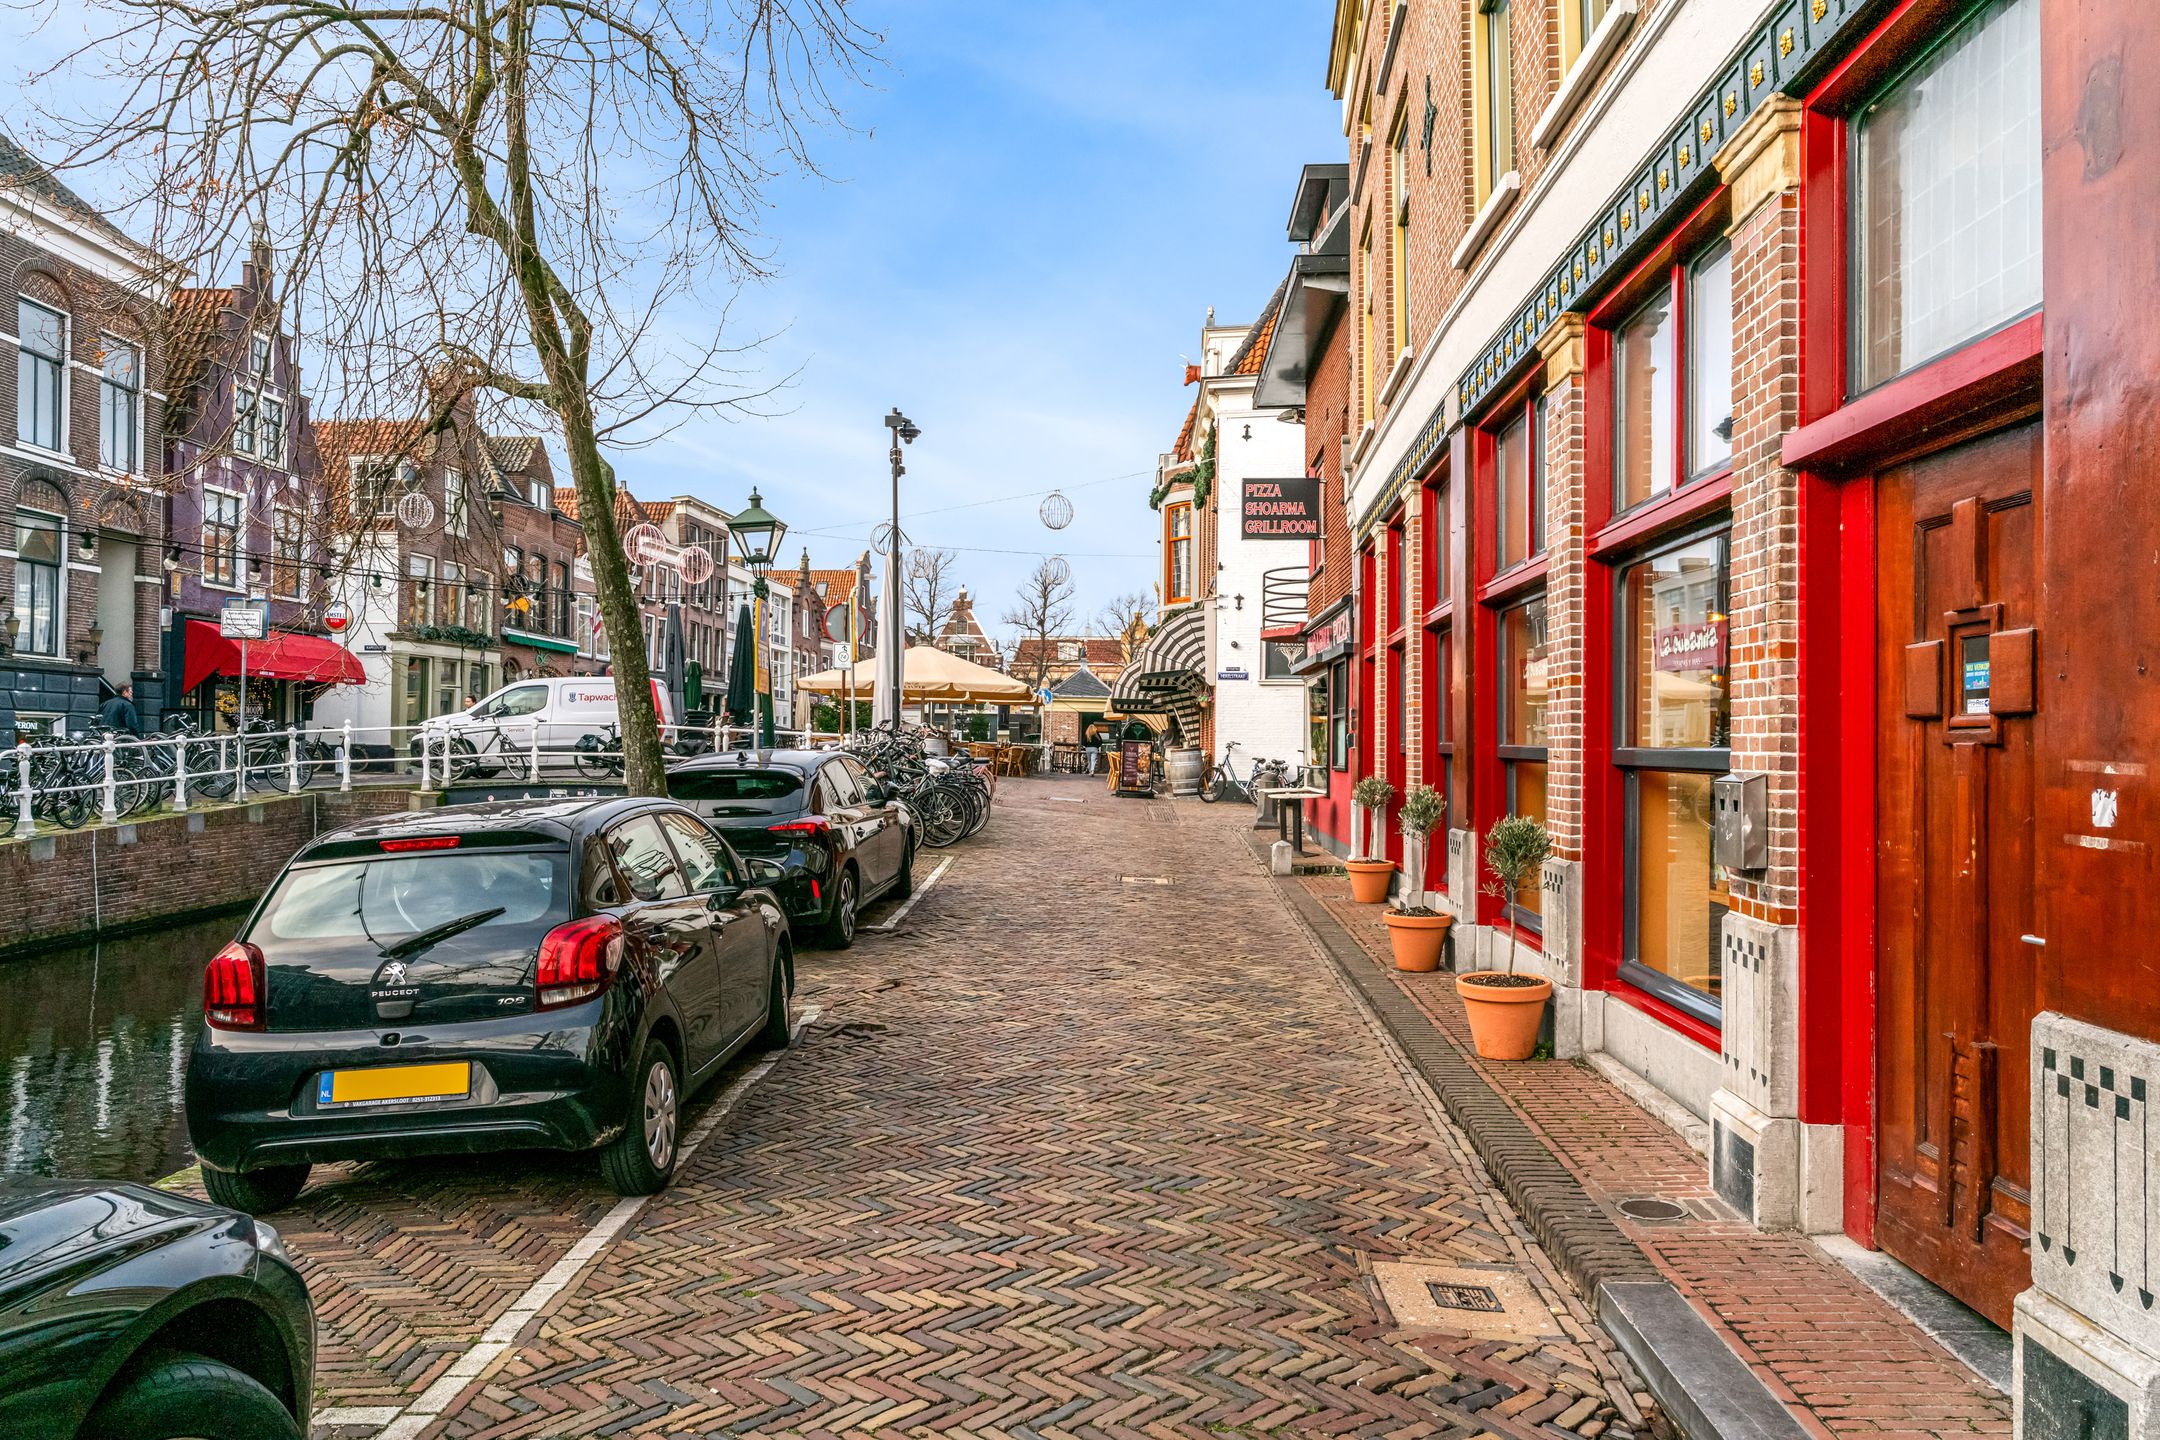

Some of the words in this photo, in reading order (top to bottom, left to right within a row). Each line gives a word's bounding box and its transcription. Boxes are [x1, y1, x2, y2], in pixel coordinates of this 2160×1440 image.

[1245, 483, 1282, 498] PIZZA
[1245, 501, 1307, 516] SHOARMA
[1244, 519, 1317, 534] GRILLROOM
[1332, 609, 1350, 647] PIZZA
[371, 988, 420, 998] PEUGEOT
[497, 996, 525, 1006] 108
[320, 1089, 332, 1098] NL
[352, 1100, 381, 1108] VAKGARAGE
[381, 1097, 409, 1105] AKERSLOOT
